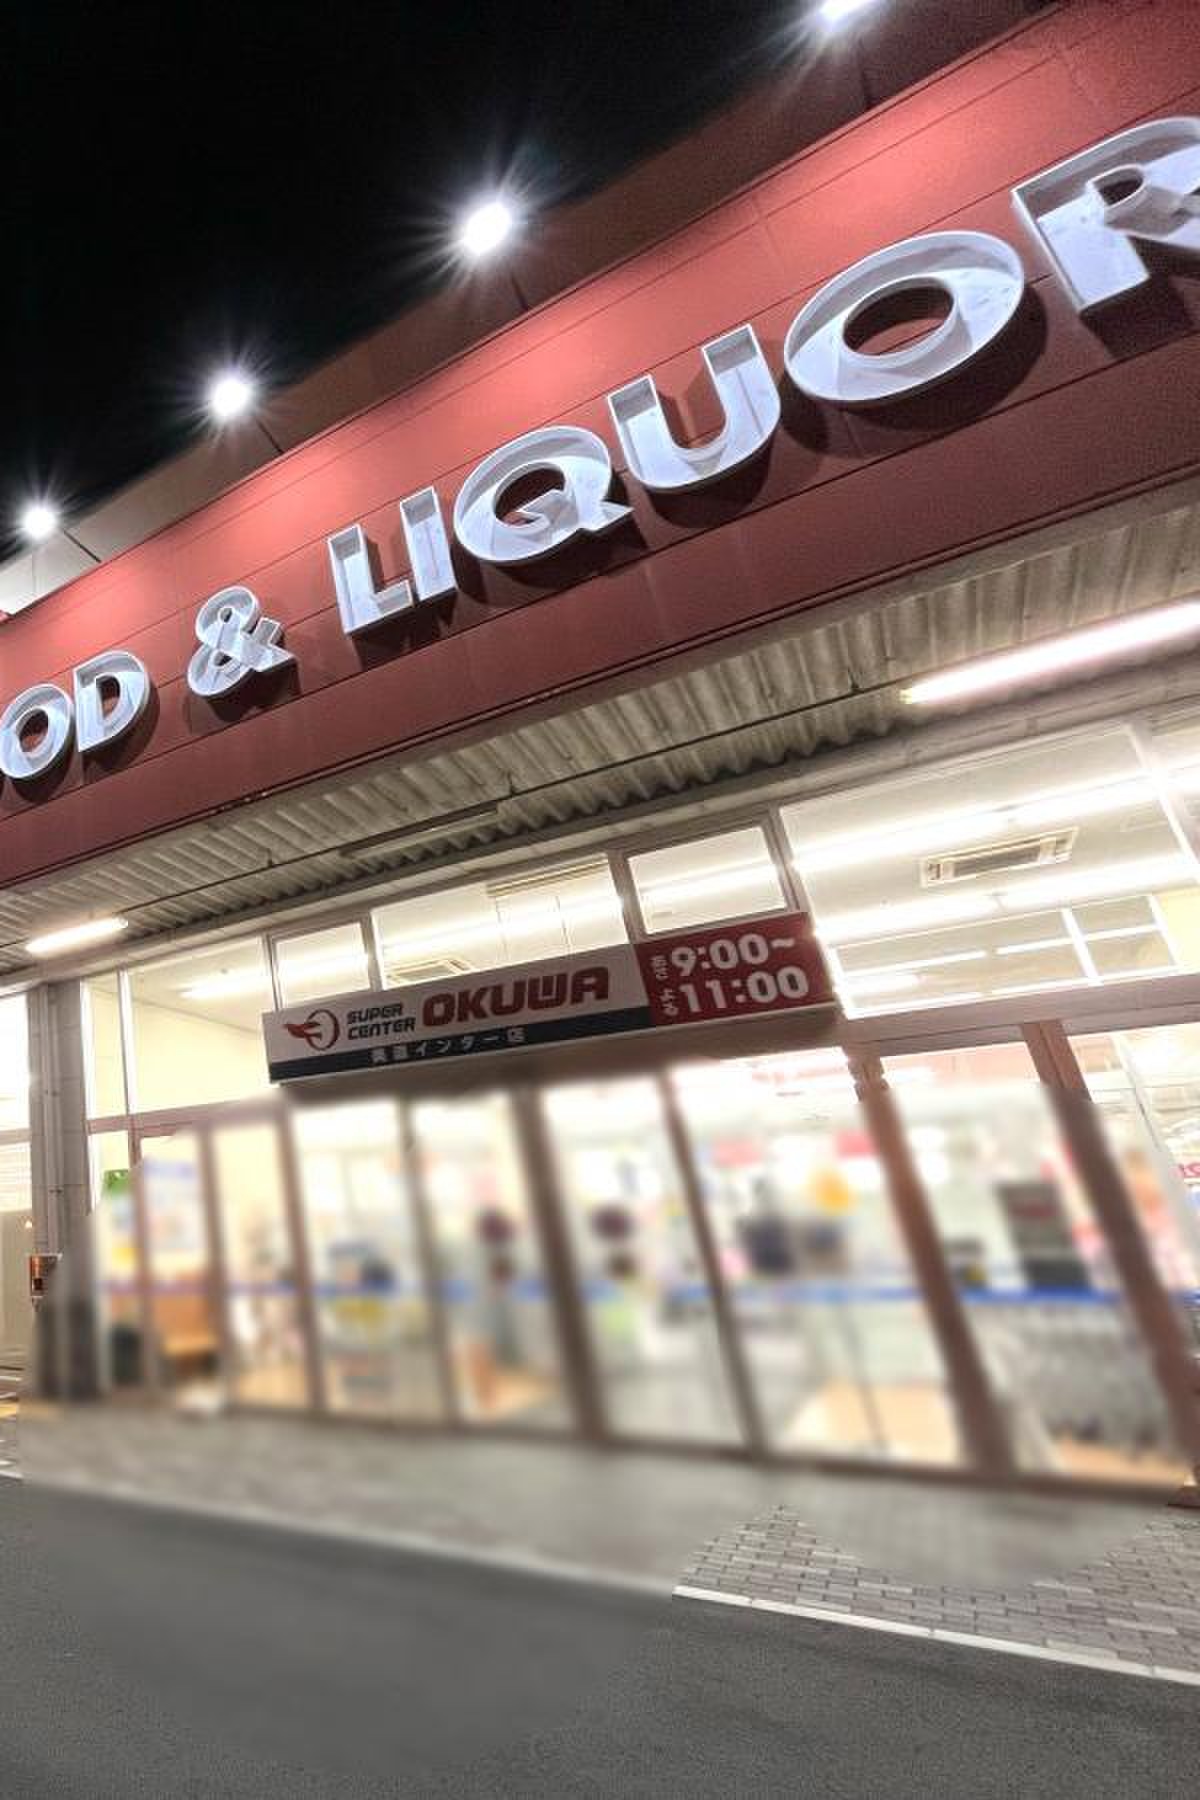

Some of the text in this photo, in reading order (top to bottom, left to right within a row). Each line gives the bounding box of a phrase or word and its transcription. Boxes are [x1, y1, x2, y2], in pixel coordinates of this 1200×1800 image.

[187, 585, 296, 697] &
[328, 115, 1200, 636] LIQUOR
[421, 966, 611, 1028] OKUWA
[679, 965, 809, 1013] 11:00
[347, 1003, 404, 1025] SUPER
[348, 1016, 417, 1041] CENTER
